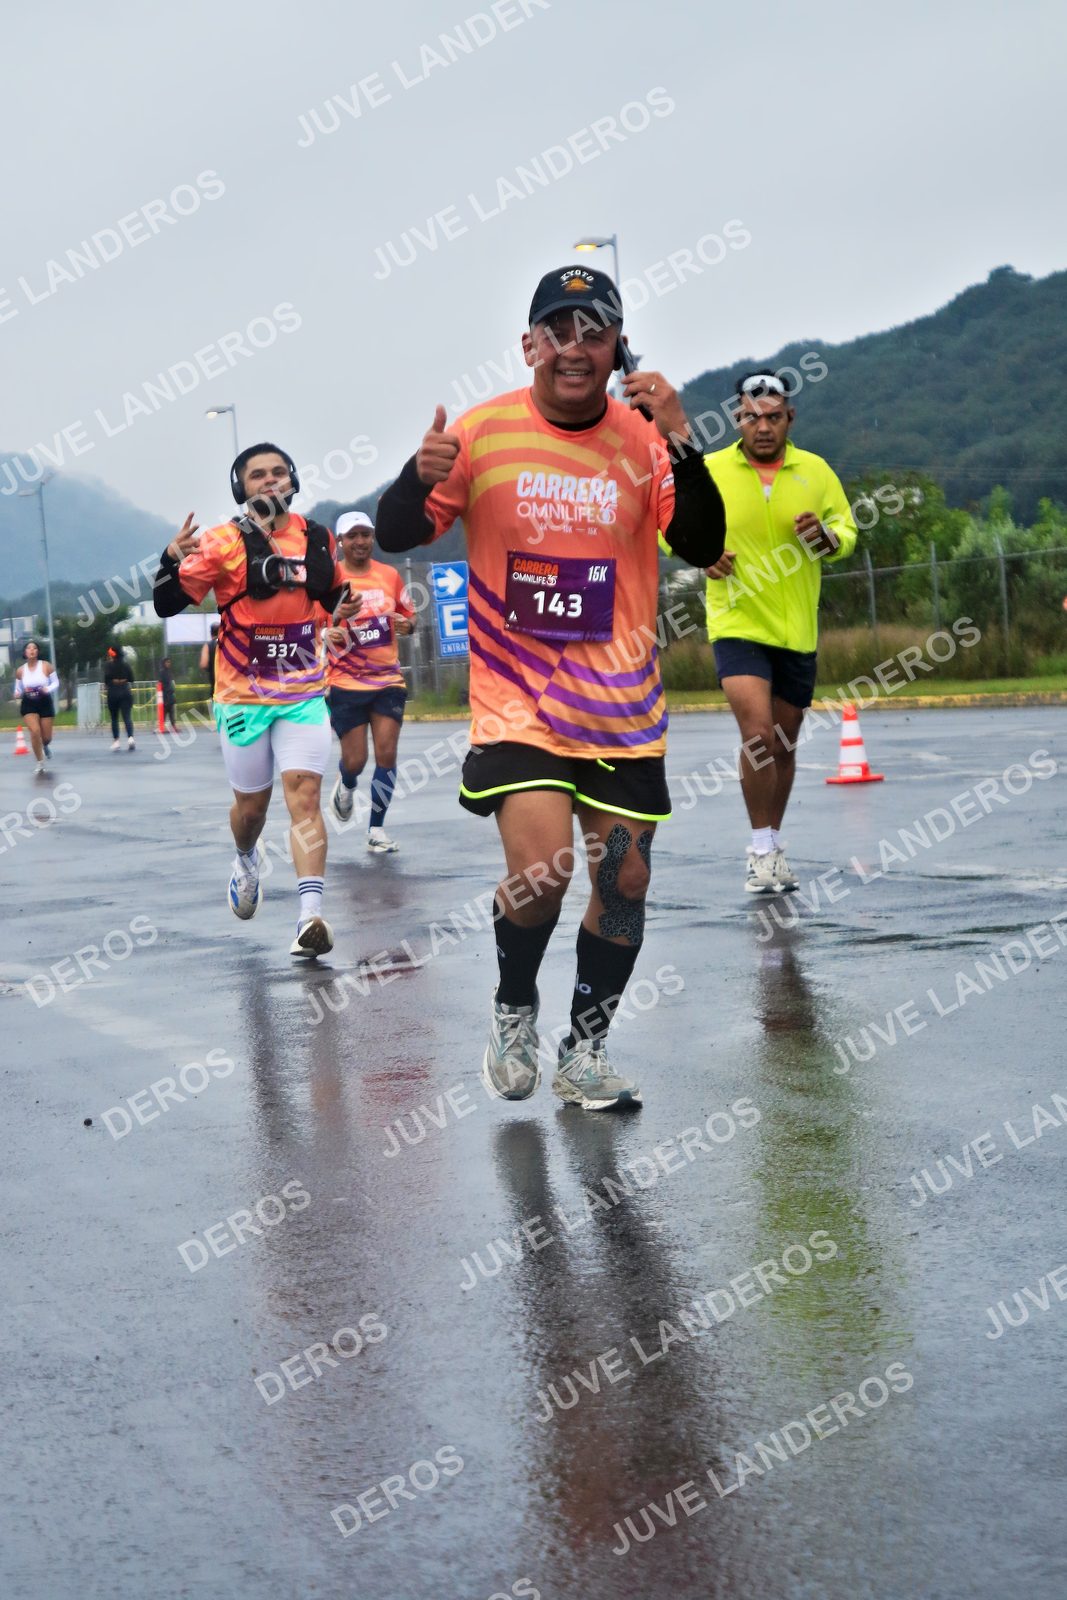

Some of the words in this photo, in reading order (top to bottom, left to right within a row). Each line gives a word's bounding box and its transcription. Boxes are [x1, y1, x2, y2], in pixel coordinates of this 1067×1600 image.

[560, 269, 595, 281] KYOTO
[517, 471, 617, 505] CARRERA
[513, 558, 559, 575] CARRERA
[533, 591, 583, 618] 143
[442, 603, 469, 637] E
[360, 629, 381, 641] 208
[267, 643, 298, 658] 337
